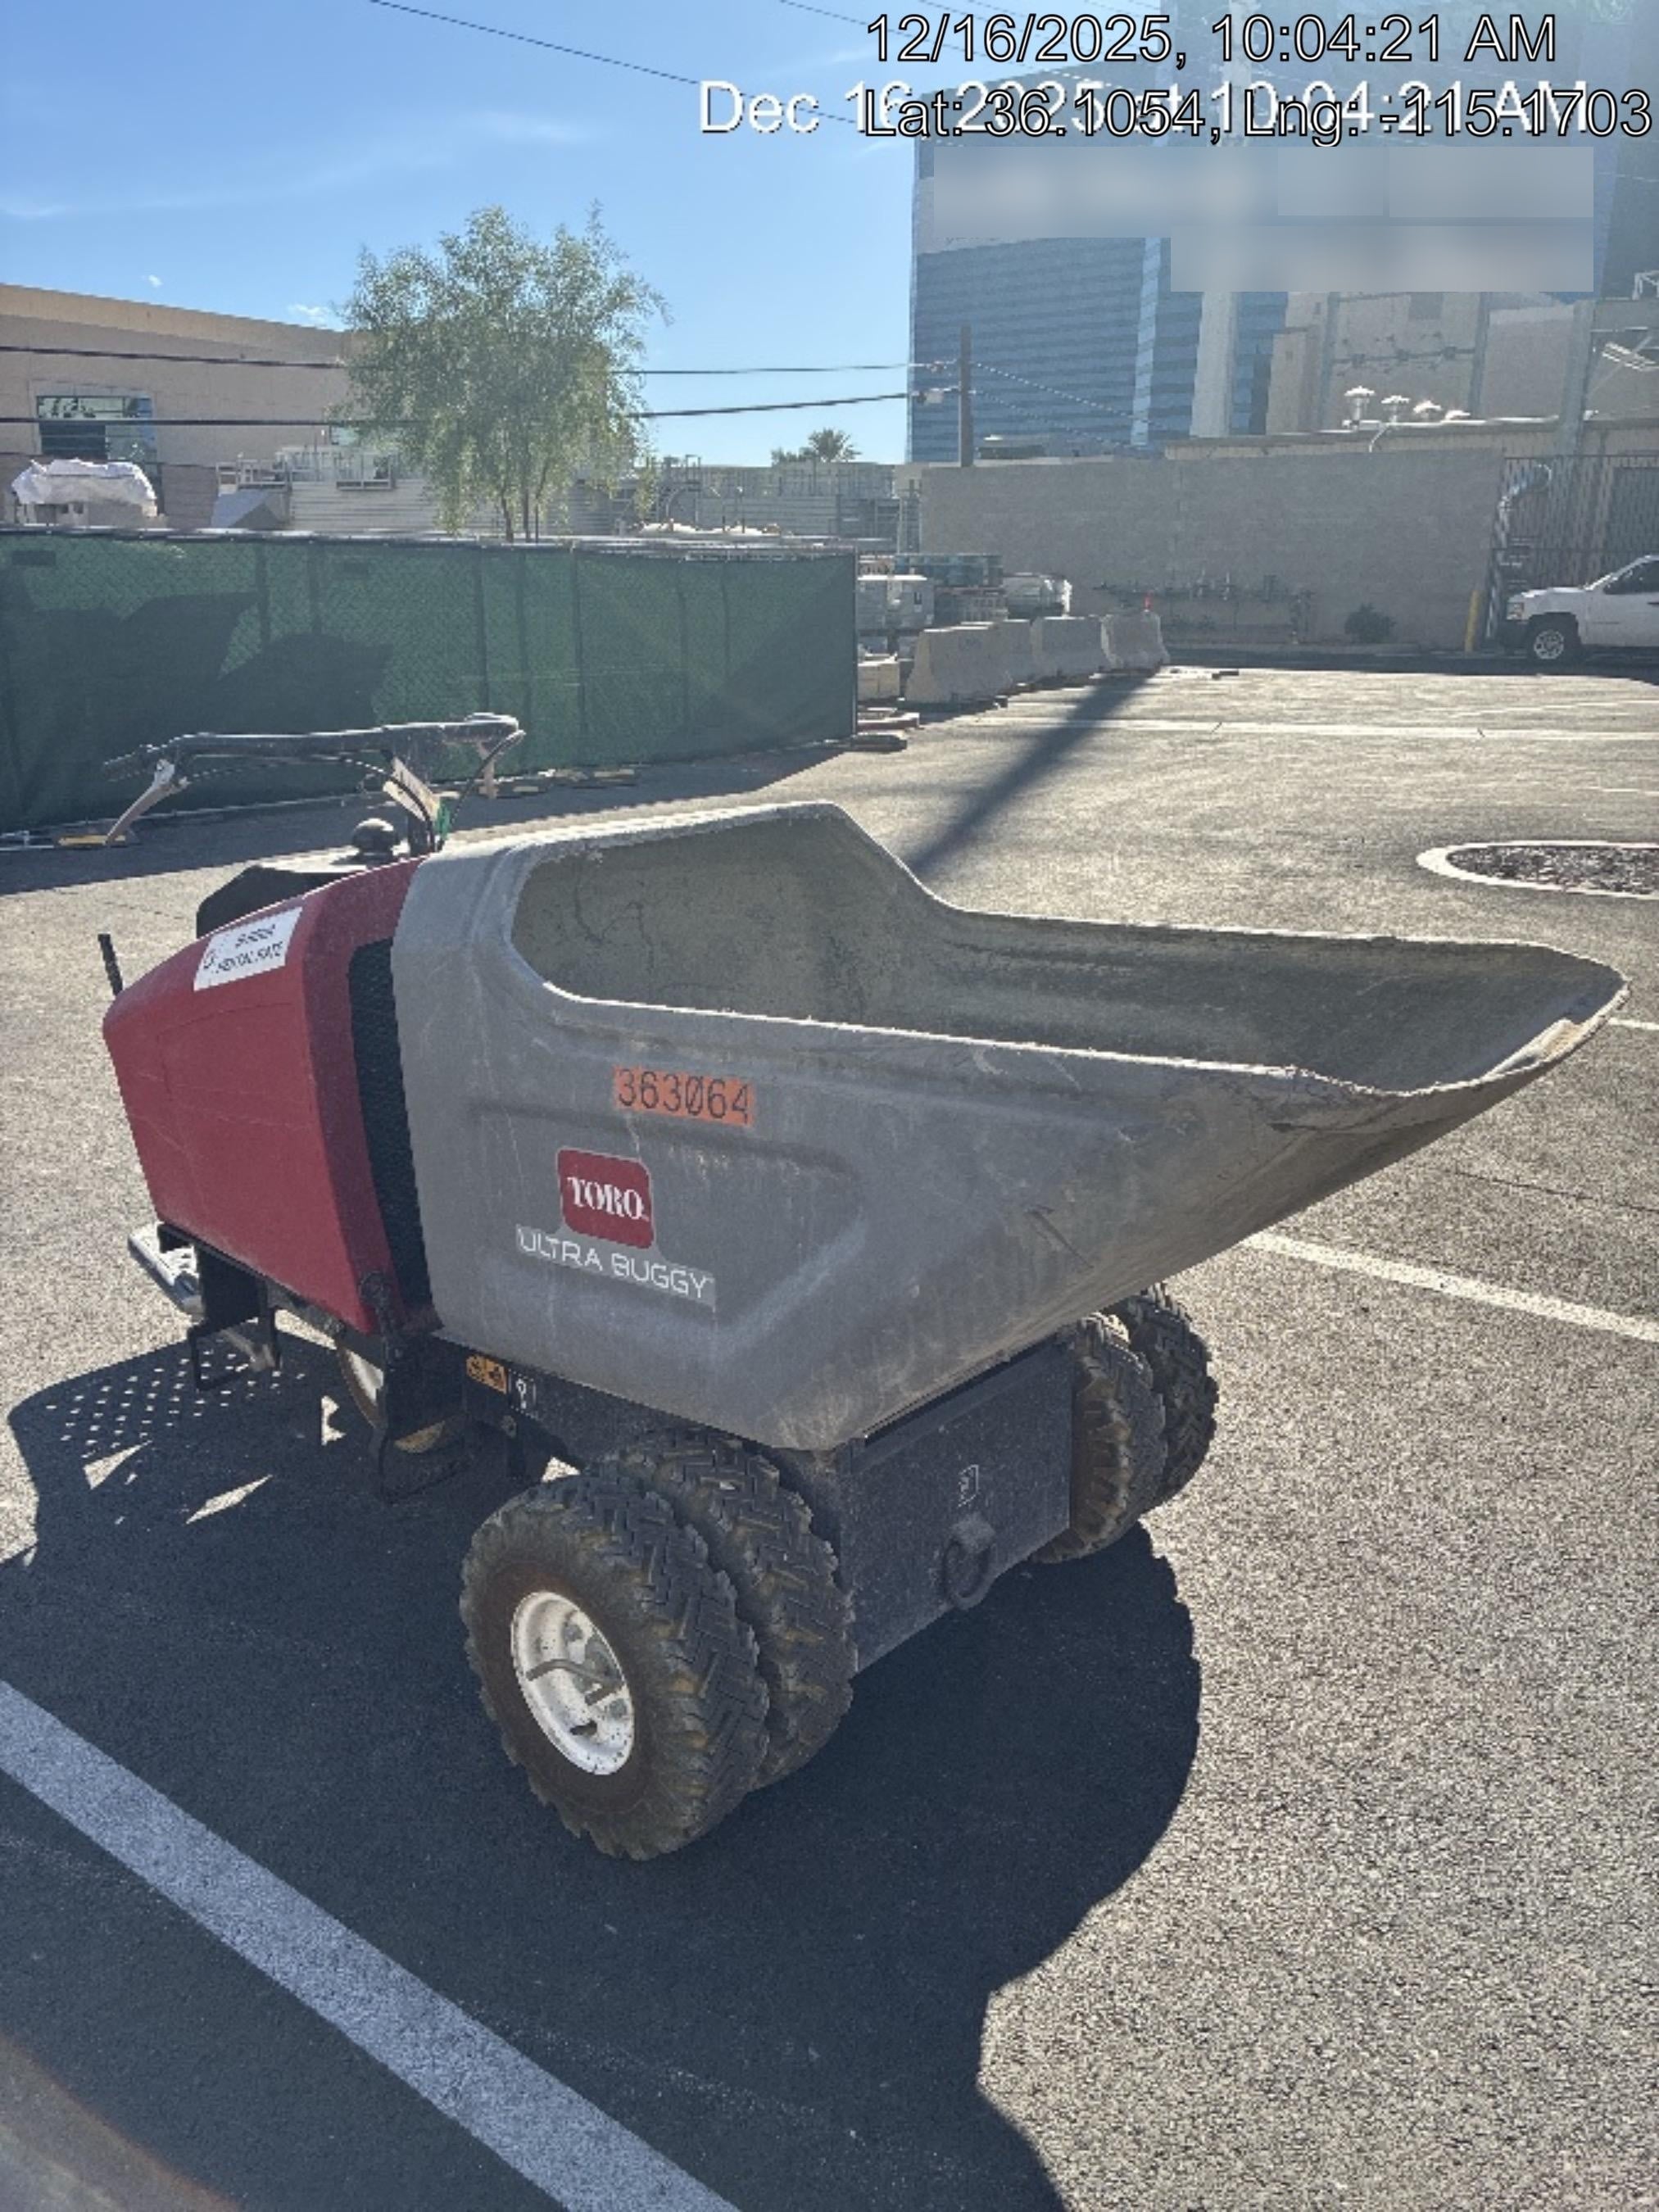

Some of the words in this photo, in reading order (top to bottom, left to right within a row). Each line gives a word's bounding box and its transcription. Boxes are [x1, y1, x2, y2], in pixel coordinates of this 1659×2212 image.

[619, 1067, 749, 1124] 363064
[567, 1176, 649, 1222] TORO
[517, 1228, 603, 1271] ULTRA
[610, 1253, 714, 1299] BUGGY
